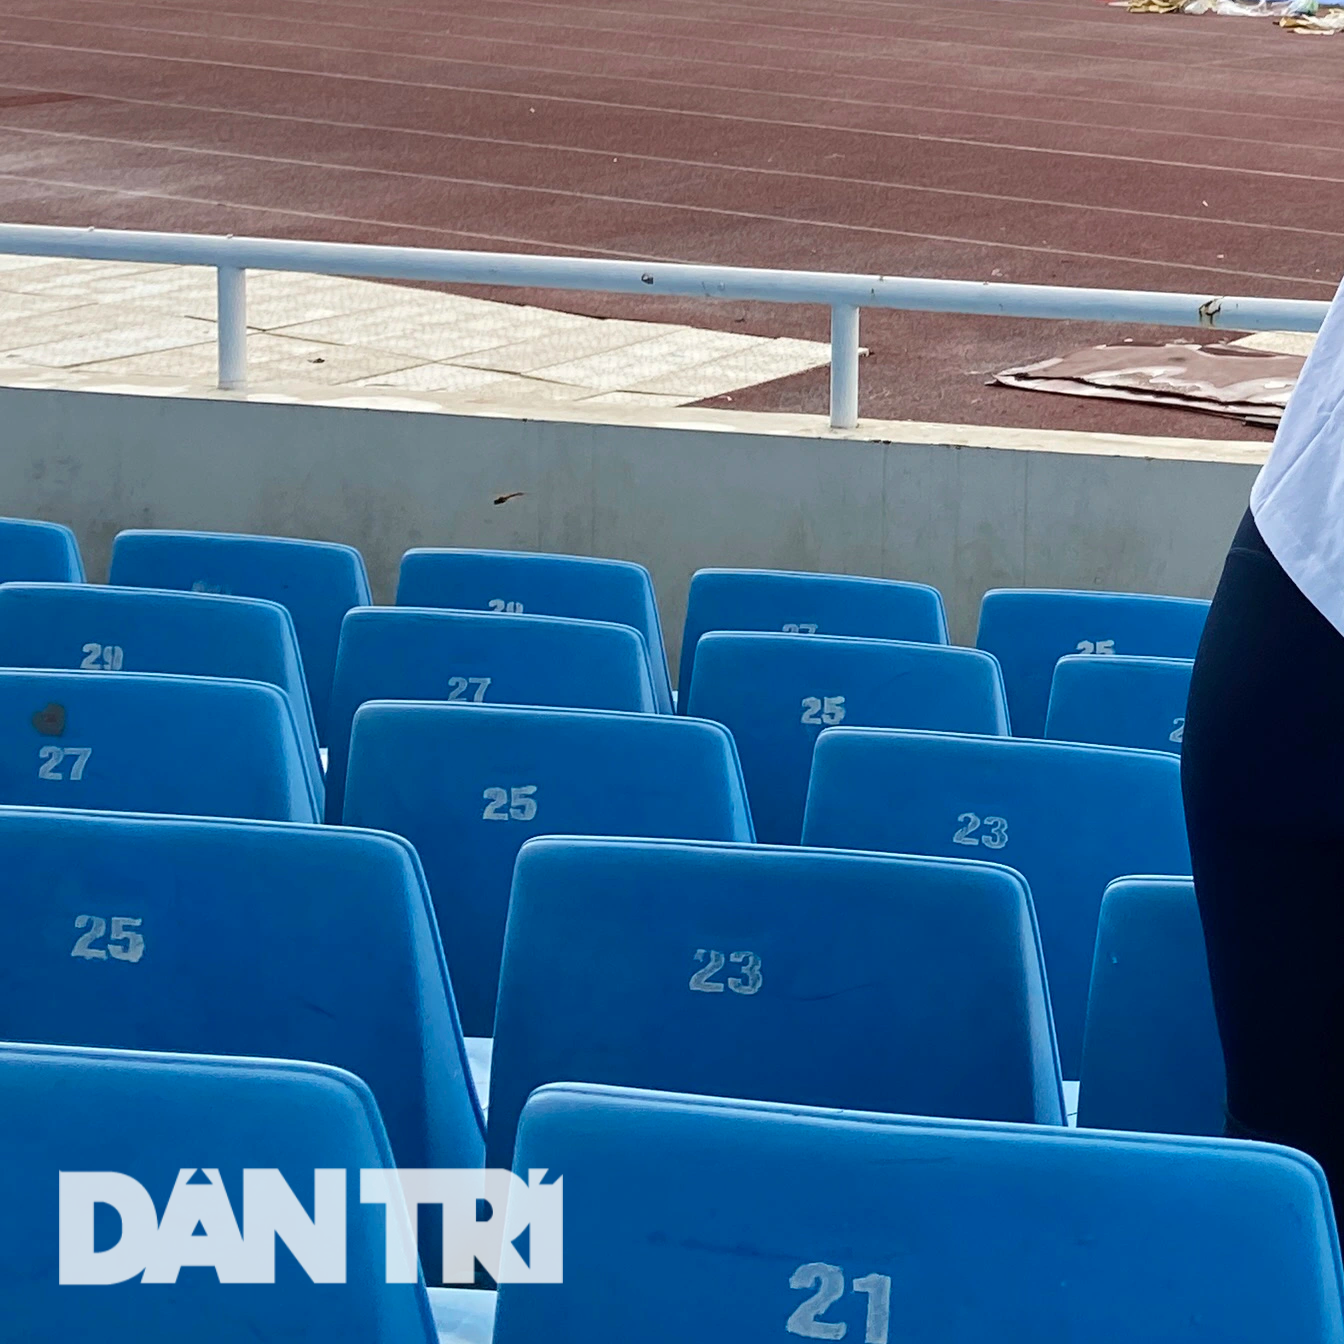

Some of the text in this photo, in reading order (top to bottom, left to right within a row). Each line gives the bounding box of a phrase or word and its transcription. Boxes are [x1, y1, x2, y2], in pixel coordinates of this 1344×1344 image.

[80, 642, 124, 672] 29
[447, 676, 492, 703] 27
[800, 696, 847, 725] 25
[38, 745, 92, 781] 27
[481, 784, 539, 822] 25
[952, 812, 1010, 851] 23
[70, 914, 147, 963] 25
[688, 948, 764, 997] 23
[785, 1261, 893, 1344] 21
